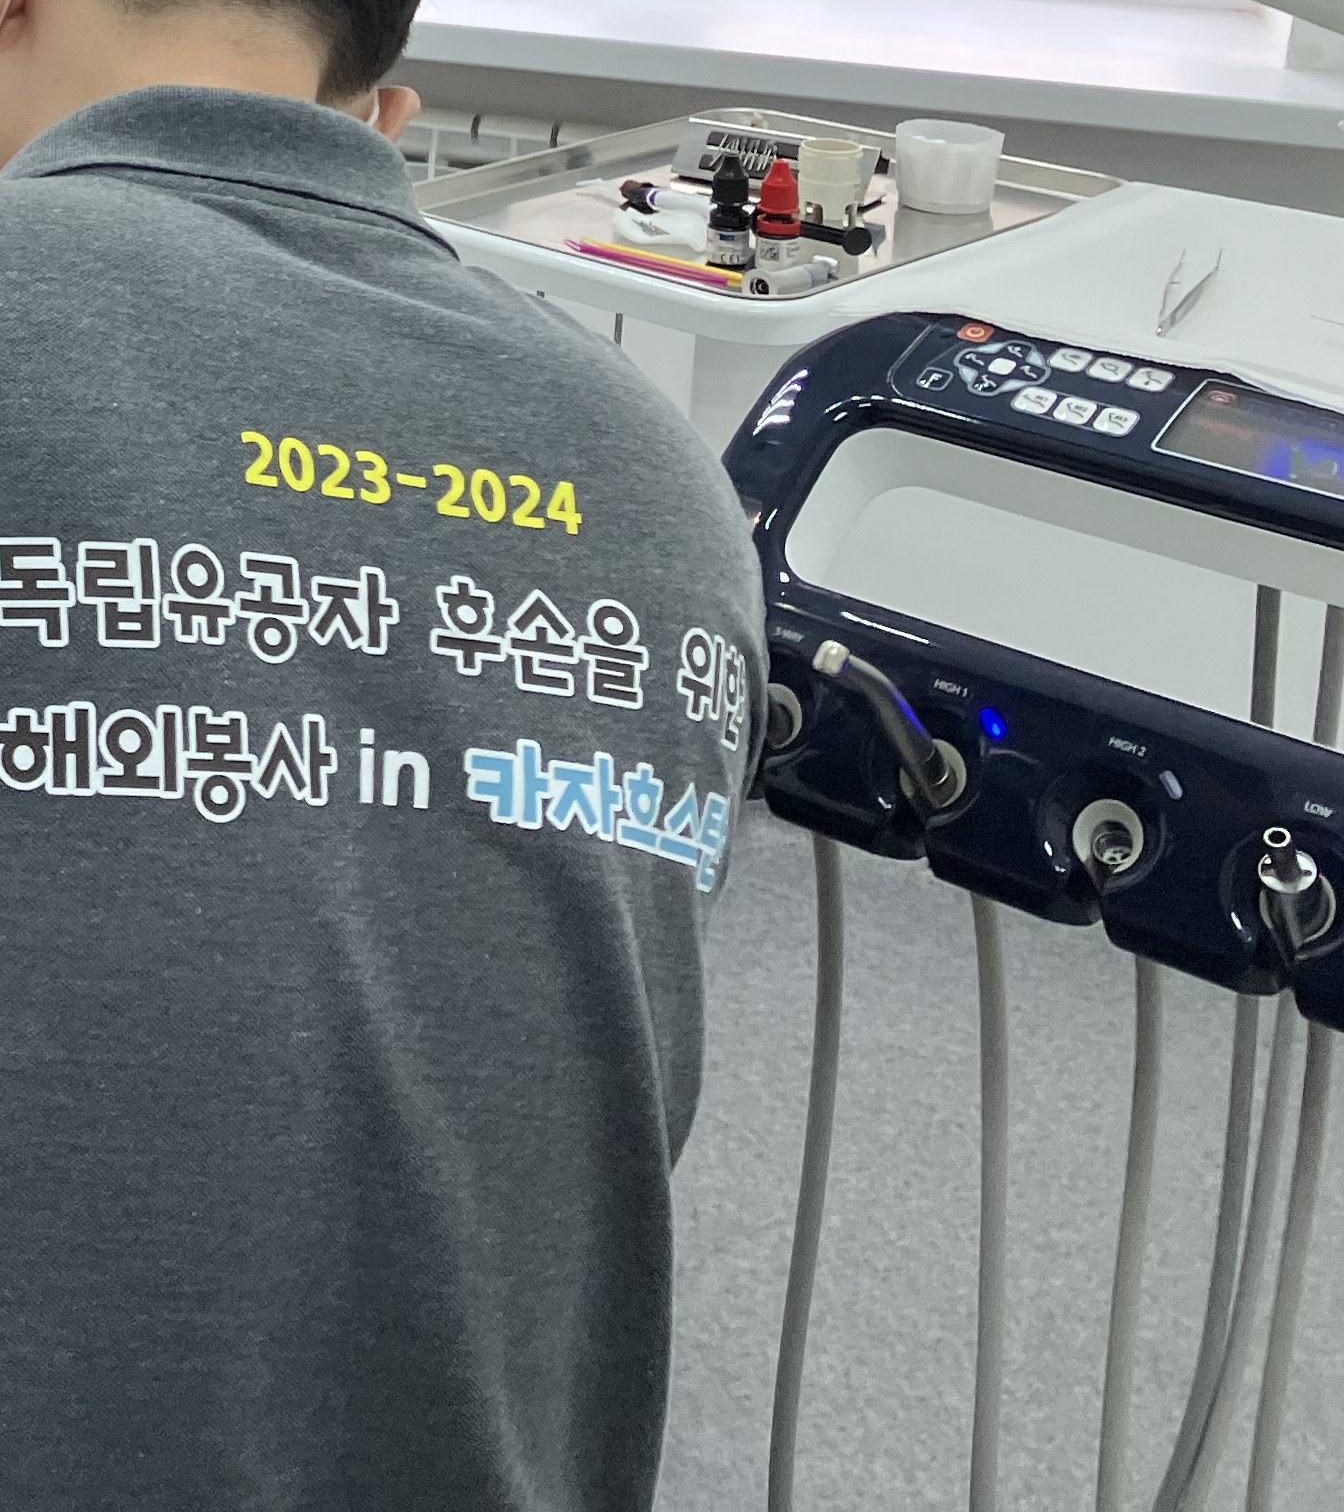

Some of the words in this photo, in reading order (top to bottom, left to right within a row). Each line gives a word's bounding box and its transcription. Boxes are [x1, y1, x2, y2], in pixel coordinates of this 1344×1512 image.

[240, 431, 583, 536] 2023-2024
[430, 574, 649, 711] 후손을
[359, 728, 431, 810] in
